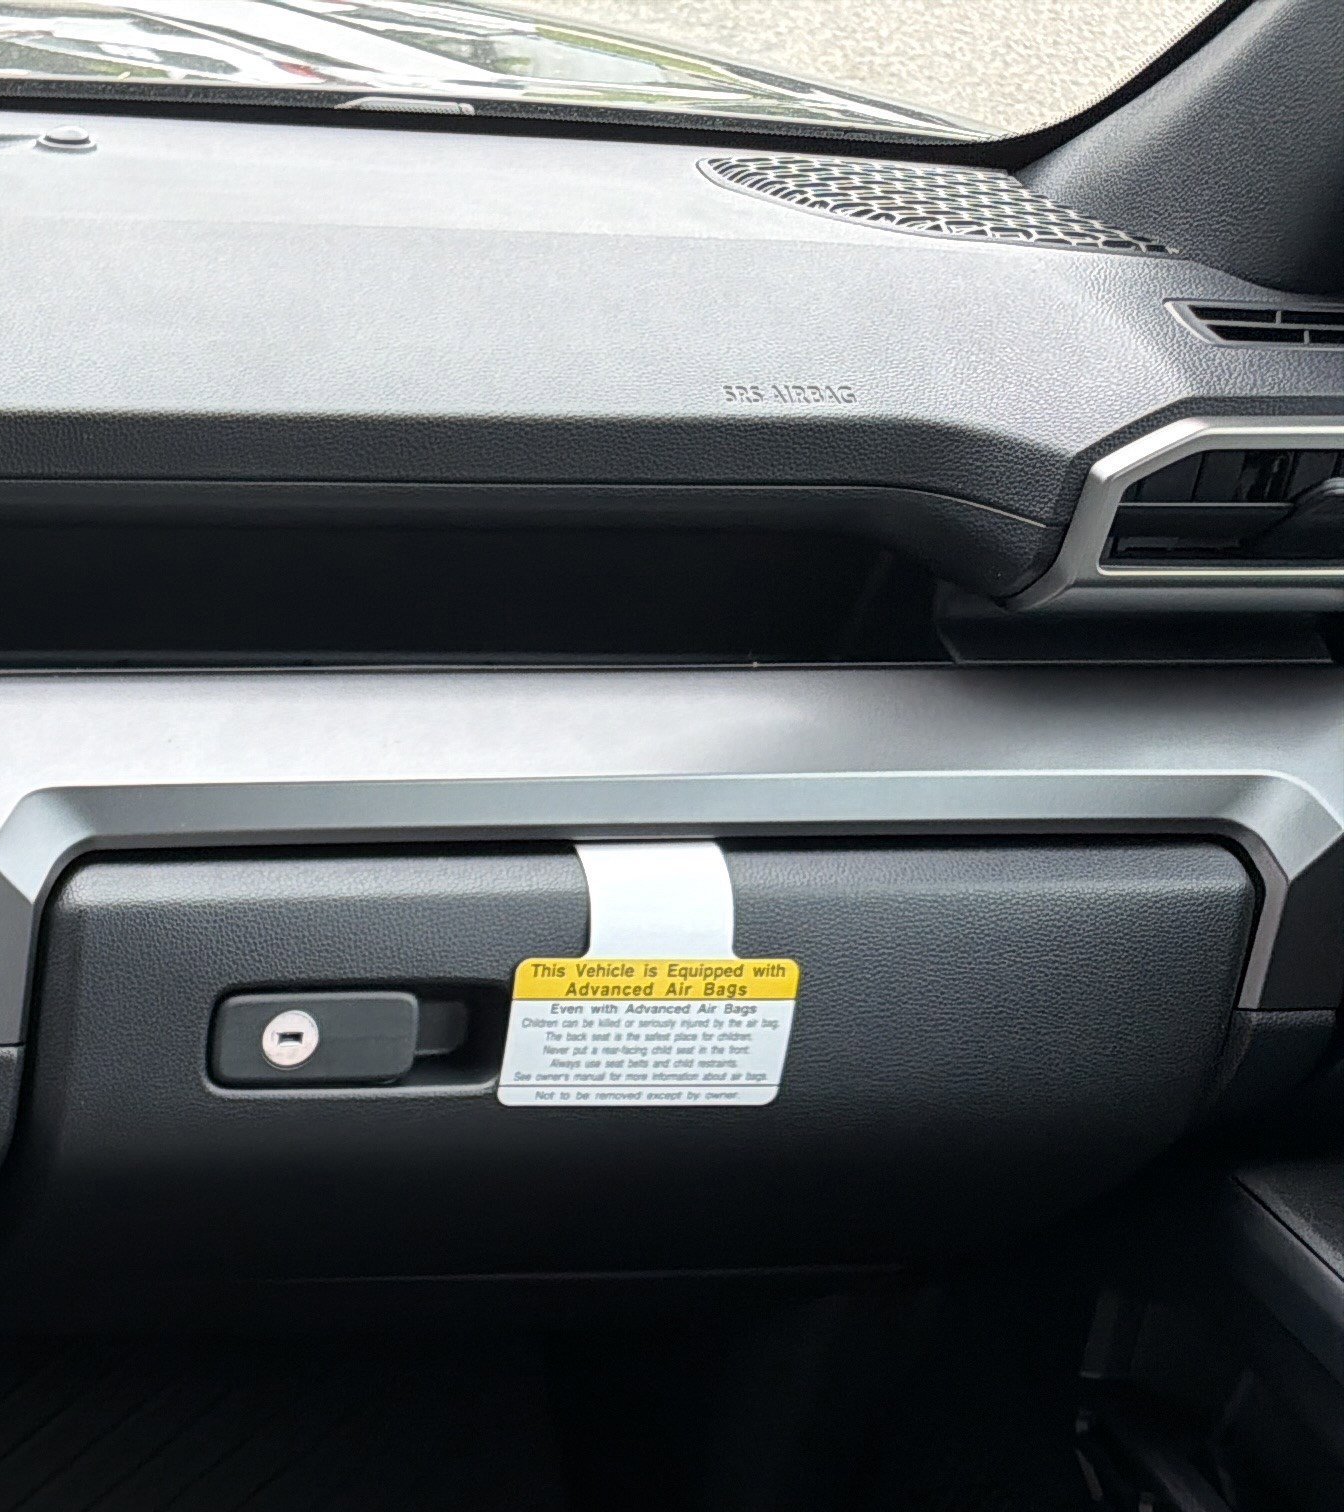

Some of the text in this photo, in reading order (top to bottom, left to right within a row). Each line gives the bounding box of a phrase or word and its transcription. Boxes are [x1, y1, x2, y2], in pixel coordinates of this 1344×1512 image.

[723, 384, 856, 404] SRS AIRBAG
[531, 963, 786, 980] This Vehicle is Equipped with
[565, 981, 748, 999] Advanced Air Bags
[550, 1003, 758, 1017] Even with Advanced Air Bags
[535, 1090, 556, 1100] Not
[560, 1091, 571, 1100] to
[575, 1090, 590, 1100] be
[594, 1090, 643, 1100] removed
